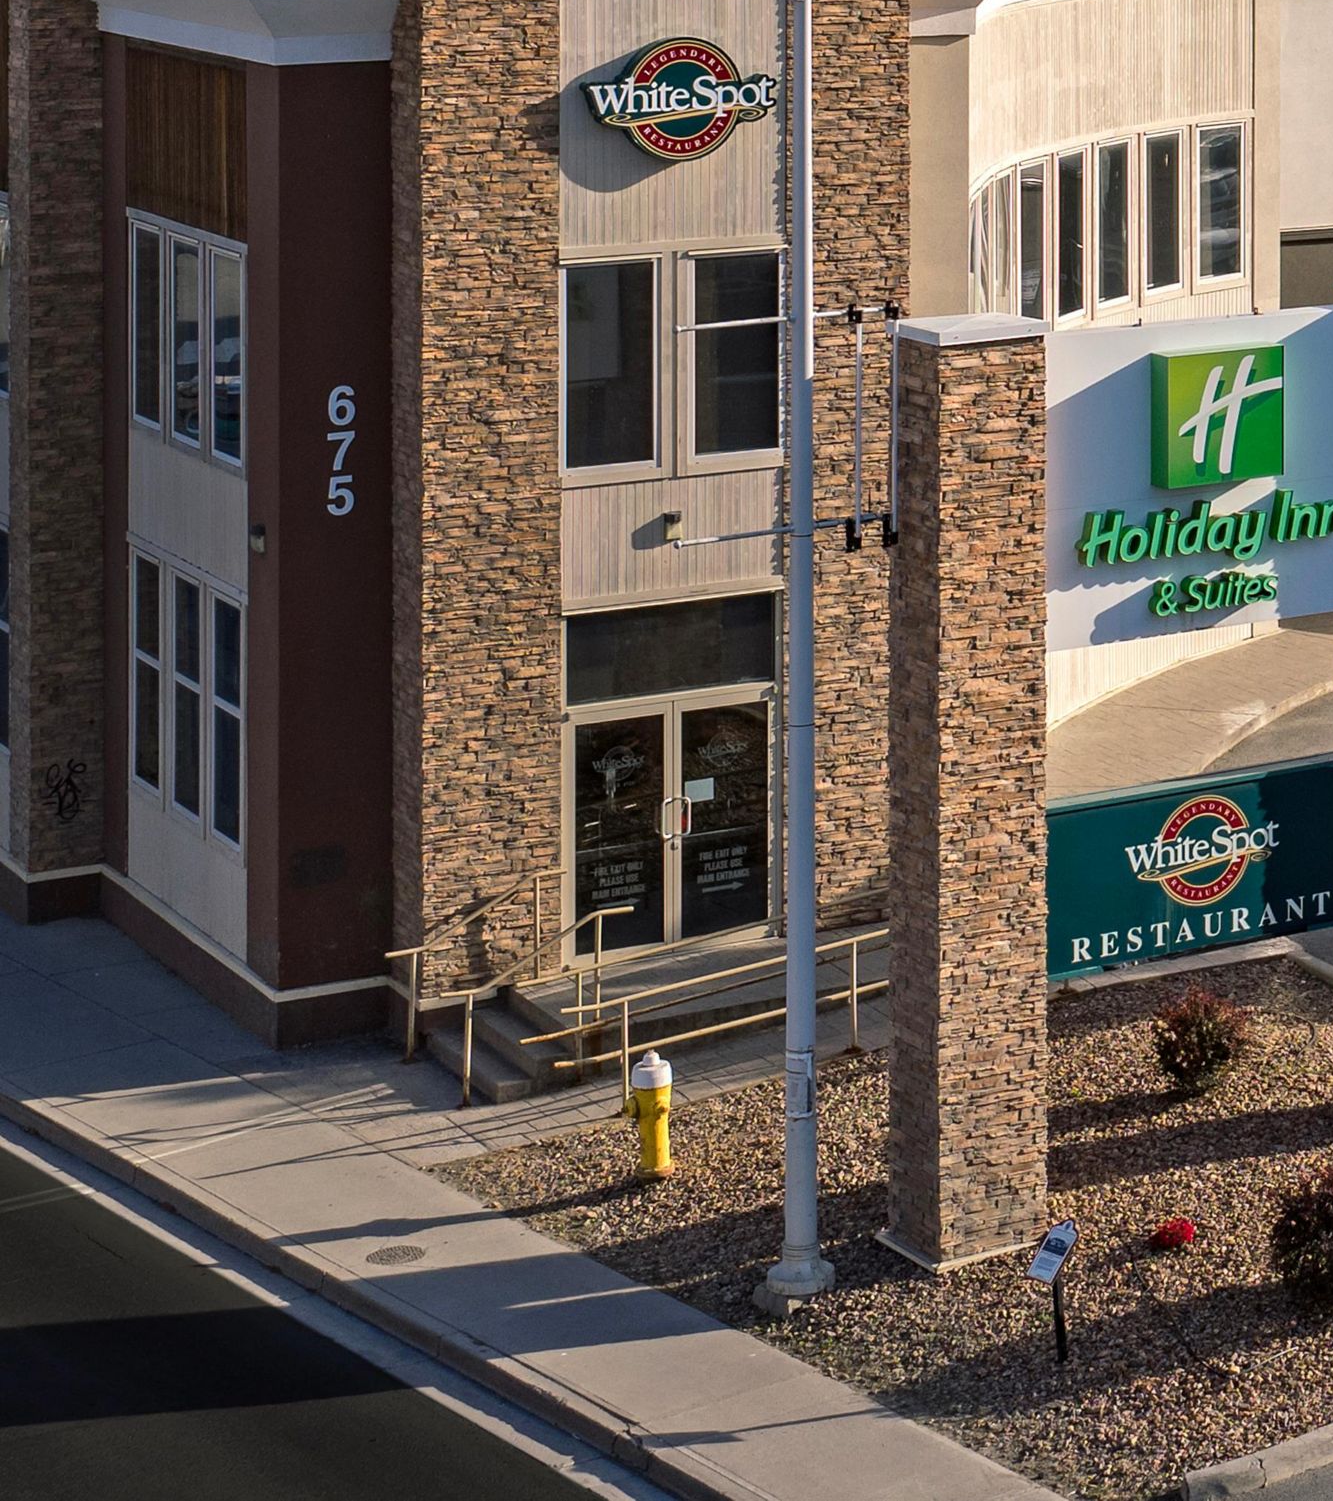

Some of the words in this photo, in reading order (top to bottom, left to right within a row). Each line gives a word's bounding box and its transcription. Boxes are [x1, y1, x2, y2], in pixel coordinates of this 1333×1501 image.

[643, 48, 724, 77] LEGENDARY
[642, 119, 726, 151] RESTAURANT
[326, 384, 356, 517] 675
[1077, 498, 1267, 568] Holiday
[1151, 579, 1178, 618] &
[1180, 571, 1279, 614] Suites
[1170, 802, 1238, 833] LEGENDARY
[599, 874, 625, 888] PLEASE
[704, 859, 729, 872] PLEASE
[716, 867, 750, 882] ENTRANCE
[611, 883, 646, 898] ENTRANCE
[1169, 864, 1239, 899] RESTAURANT
[1070, 890, 1332, 964] RESTAURANT
